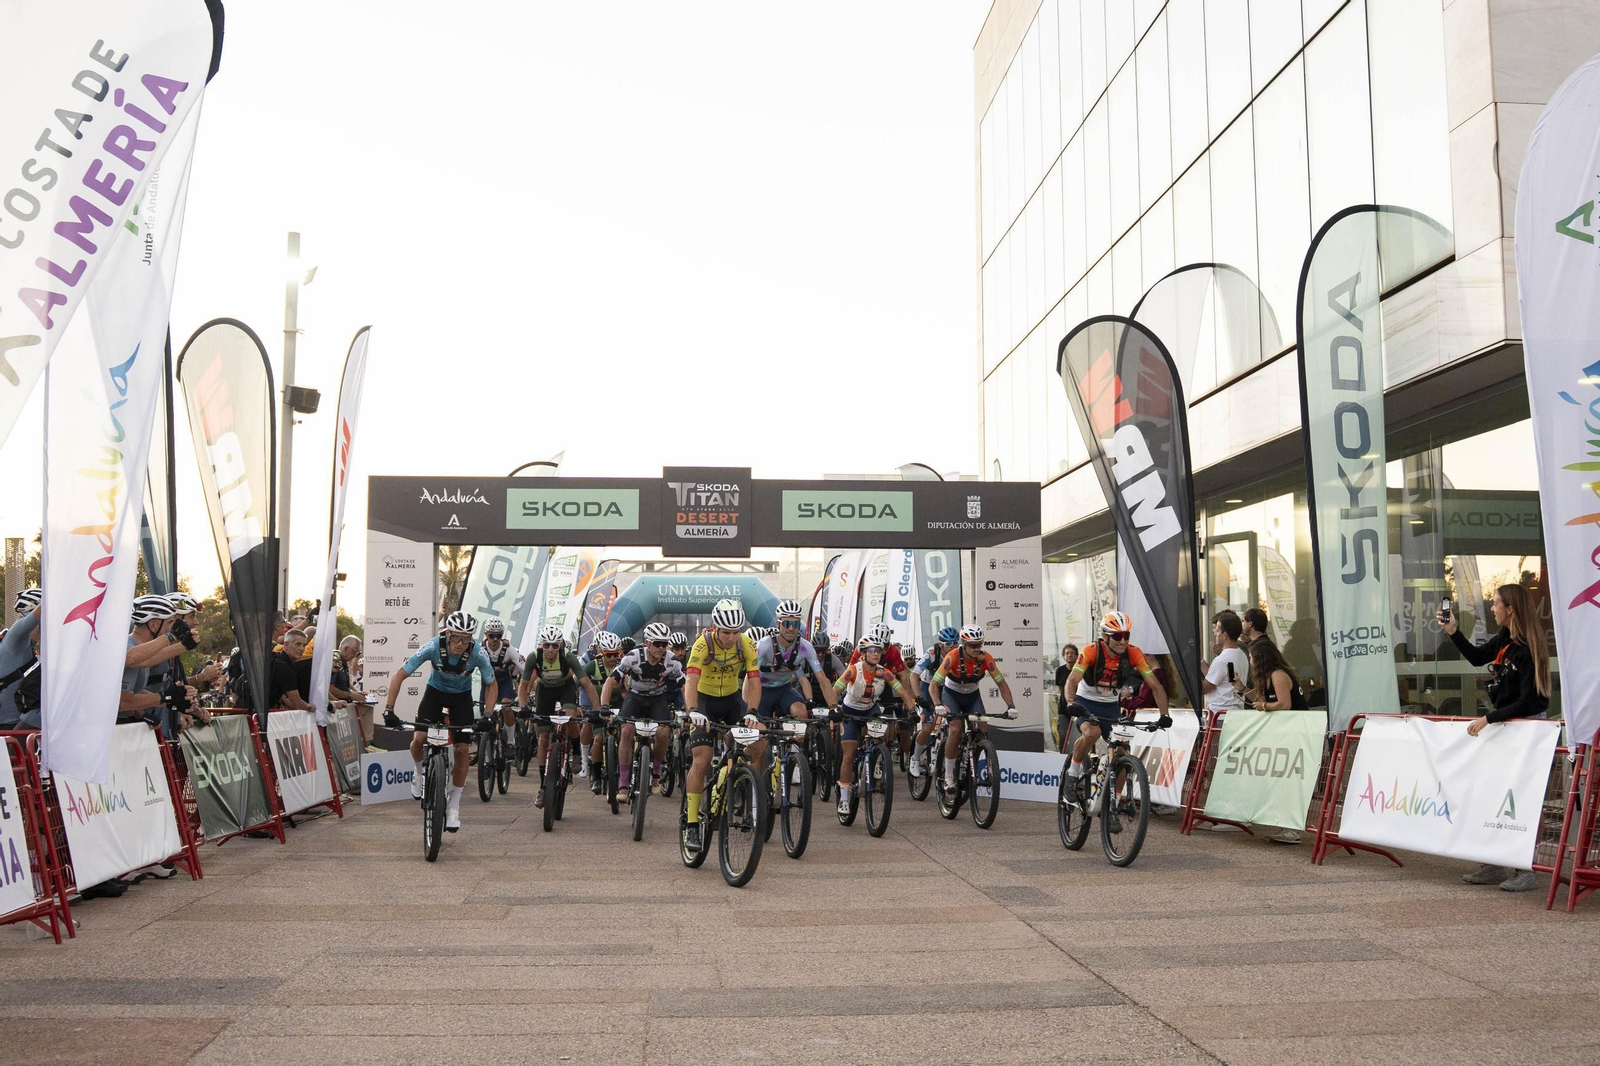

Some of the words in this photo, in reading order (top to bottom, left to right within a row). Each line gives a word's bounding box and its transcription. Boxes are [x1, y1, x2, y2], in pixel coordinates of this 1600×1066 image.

[71, 39, 129, 103] DE
[17, 73, 189, 331] ALMERÍA
[142, 232, 154, 266] Junta
[419, 487, 490, 505] Andalucía
[667, 482, 740, 507] TITAN
[676, 512, 739, 523] DESERT
[927, 521, 974, 529] DIPUTACIÓN
[987, 521, 1020, 530] ALMERÍA
[684, 527, 729, 536] ALMERÍA
[658, 585, 741, 596] UNIVERSAE
[386, 768, 414, 785] Clear
[1000, 767, 1060, 786] Clearden
[65, 772, 132, 827] Andalucía
[1357, 772, 1453, 825] Andalucía
[1483, 821, 1495, 829] Junta
[1496, 821, 1503, 830] de
[1504, 823, 1527, 832] Andalucía
